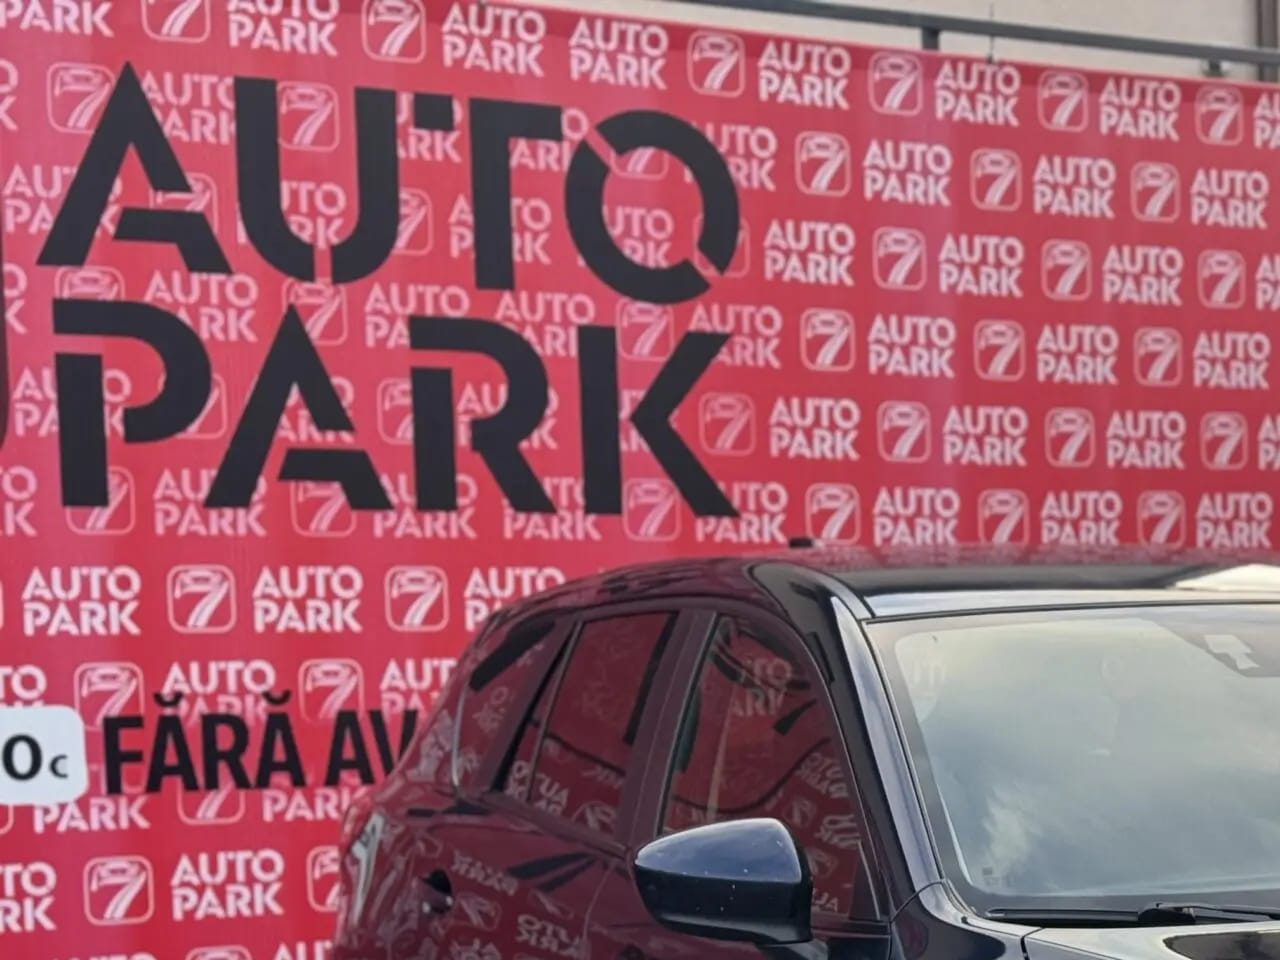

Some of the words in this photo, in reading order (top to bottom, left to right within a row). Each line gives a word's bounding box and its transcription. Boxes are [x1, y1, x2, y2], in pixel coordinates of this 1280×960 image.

[228, 13, 338, 57] PARK
[442, 5, 546, 43] AUTO
[569, 18, 669, 57] AUTO
[442, 35, 544, 77] PARK
[570, 50, 667, 90] PARK
[758, 40, 851, 72] AUTO
[759, 70, 851, 110] PARK
[935, 60, 1020, 95] AUTO
[1099, 77, 1181, 110] AUTO
[935, 89, 1020, 127] PARK
[1100, 108, 1180, 142] PARK
[863, 139, 952, 175] AUTO
[1032, 155, 1116, 188] AUTO
[36, 61, 741, 306] AUTO
[863, 168, 951, 206] PARK
[1190, 168, 1268, 200] AUTO
[1033, 185, 1115, 219] PARK
[1191, 197, 1268, 230] PARK
[764, 219, 856, 253] AUTO
[939, 233, 1024, 266] AUTO
[764, 250, 855, 287] PARK
[1102, 245, 1183, 277] AUTO
[143, 269, 259, 308] AUTO
[940, 263, 1023, 298] PARK
[1103, 276, 1182, 307] PARK
[364, 281, 470, 317] AUTO
[495, 290, 596, 325] AUTO
[687, 303, 782, 337] AUTO
[868, 314, 957, 347] AUTO
[1037, 324, 1119, 355] AUTO
[1193, 331, 1270, 361] AUTO
[868, 345, 955, 378] PARK
[1037, 353, 1118, 385] PARK
[1194, 360, 1269, 390] PARK
[52, 297, 741, 519] PARK
[770, 396, 861, 428] AUTO
[943, 405, 1028, 437] AUTO
[1106, 410, 1186, 441] AUTO
[770, 428, 860, 461] PARK
[944, 433, 1027, 466] PARK
[1107, 440, 1184, 470] PARK
[873, 487, 960, 518] AUTO
[1041, 491, 1122, 521] AUTO
[1196, 493, 1273, 521] AUTO
[873, 518, 959, 547] PARK
[1041, 519, 1121, 546] PARK
[1197, 520, 1272, 549] PARK
[21, 565, 142, 601] AUTO
[252, 565, 363, 600] AUTO
[23, 600, 142, 637] PARK
[254, 598, 363, 634] PARK
[161, 659, 277, 695] AUTO
[102, 689, 307, 795] FĂRĂ
[33, 795, 152, 835] PARK
[170, 849, 284, 887] AUTO
[172, 882, 284, 922] PARK
